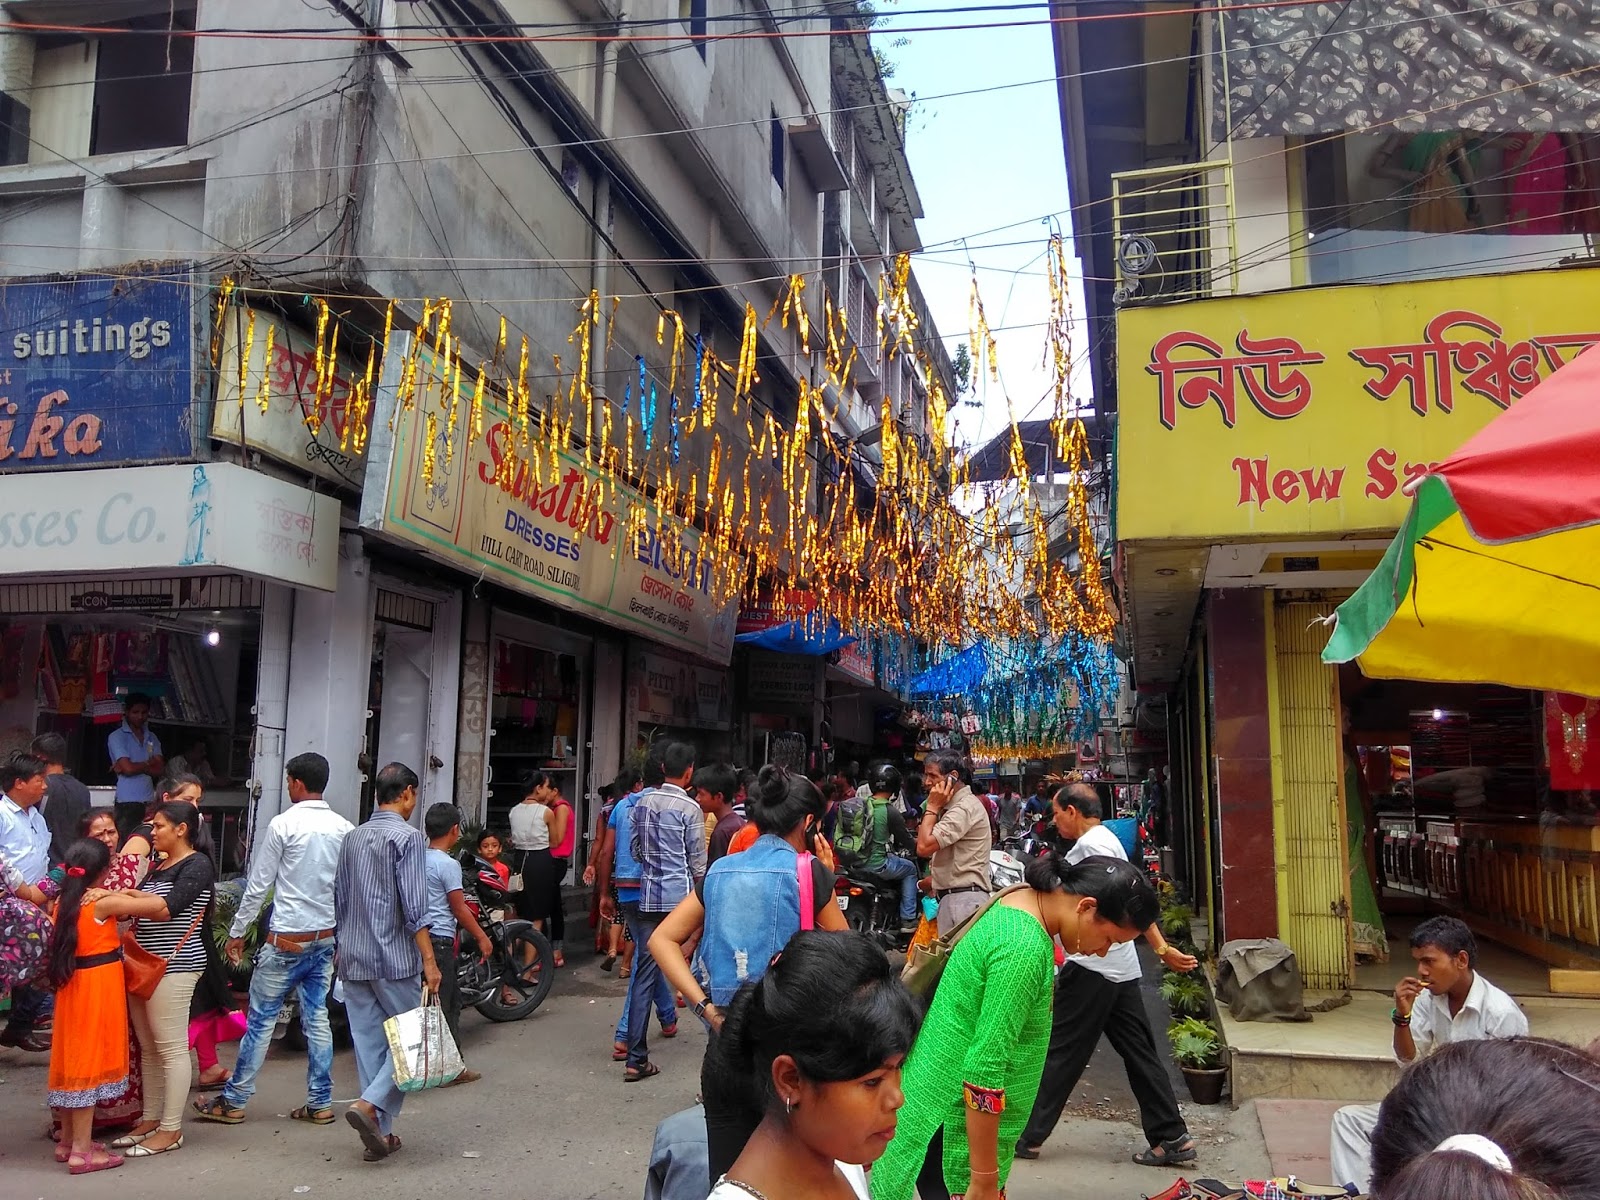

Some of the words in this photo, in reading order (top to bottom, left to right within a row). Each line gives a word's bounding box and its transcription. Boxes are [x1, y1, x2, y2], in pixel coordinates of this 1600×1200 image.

[13, 317, 171, 359] suitings
[1145, 329, 1326, 430] নিউ
[0, 389, 102, 460] ika
[1232, 454, 1347, 511] New
[96, 492, 166, 546] Co.
[504, 509, 580, 561] DRESSES
[481, 535, 503, 559] HILL
[505, 546, 524, 568] CART
[82, 595, 108, 606] ICON
[138, 596, 161, 605] COTTON
